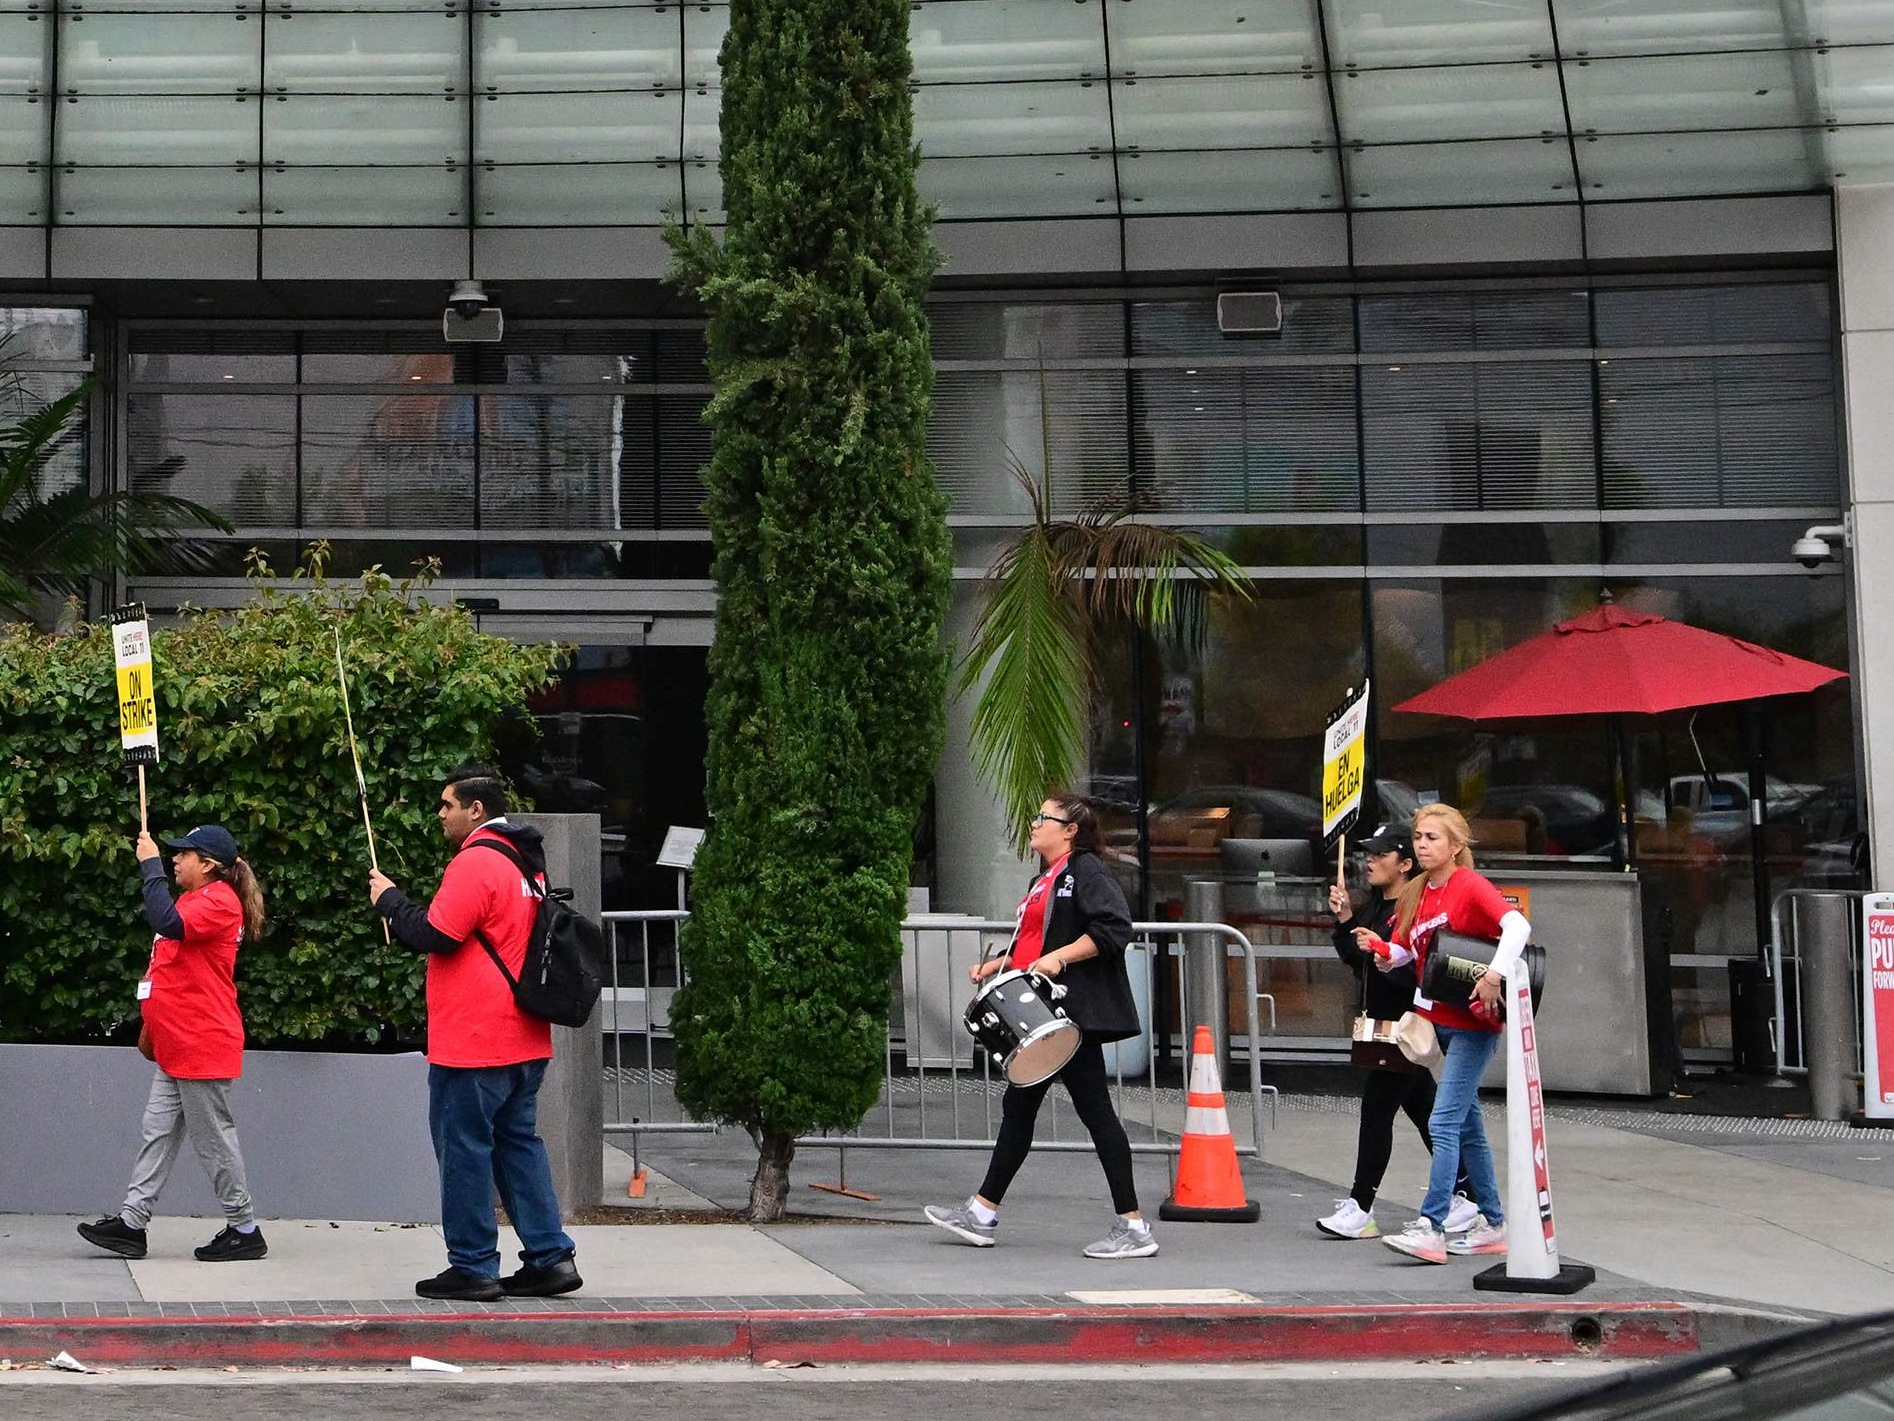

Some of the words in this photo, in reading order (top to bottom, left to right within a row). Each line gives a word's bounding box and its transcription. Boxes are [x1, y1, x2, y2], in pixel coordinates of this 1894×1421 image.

[129, 669, 142, 699] ON
[122, 698, 153, 731] STRIKE
[1338, 749, 1350, 779] EN
[1325, 766, 1360, 818] HUELGA
